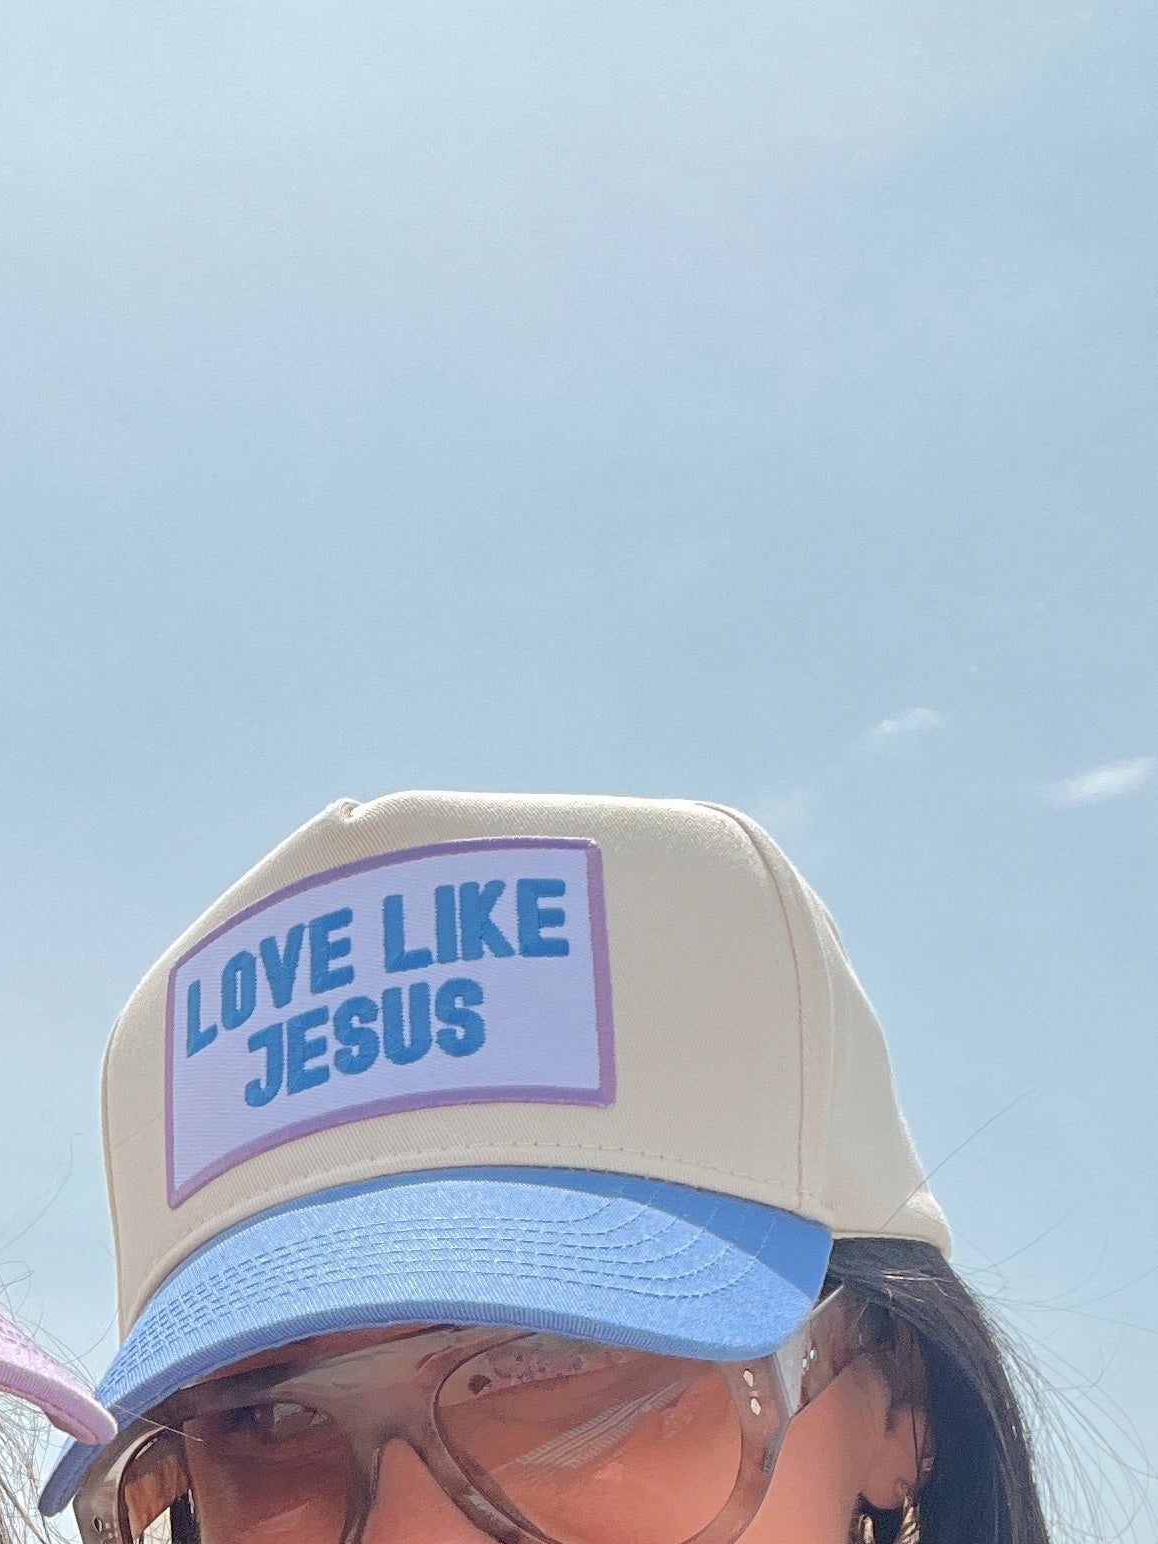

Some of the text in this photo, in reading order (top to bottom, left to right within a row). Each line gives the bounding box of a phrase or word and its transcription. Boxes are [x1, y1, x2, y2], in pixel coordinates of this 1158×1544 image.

[186, 878, 570, 1058] LOVE LIKE
[244, 977, 487, 1108] JESUS
